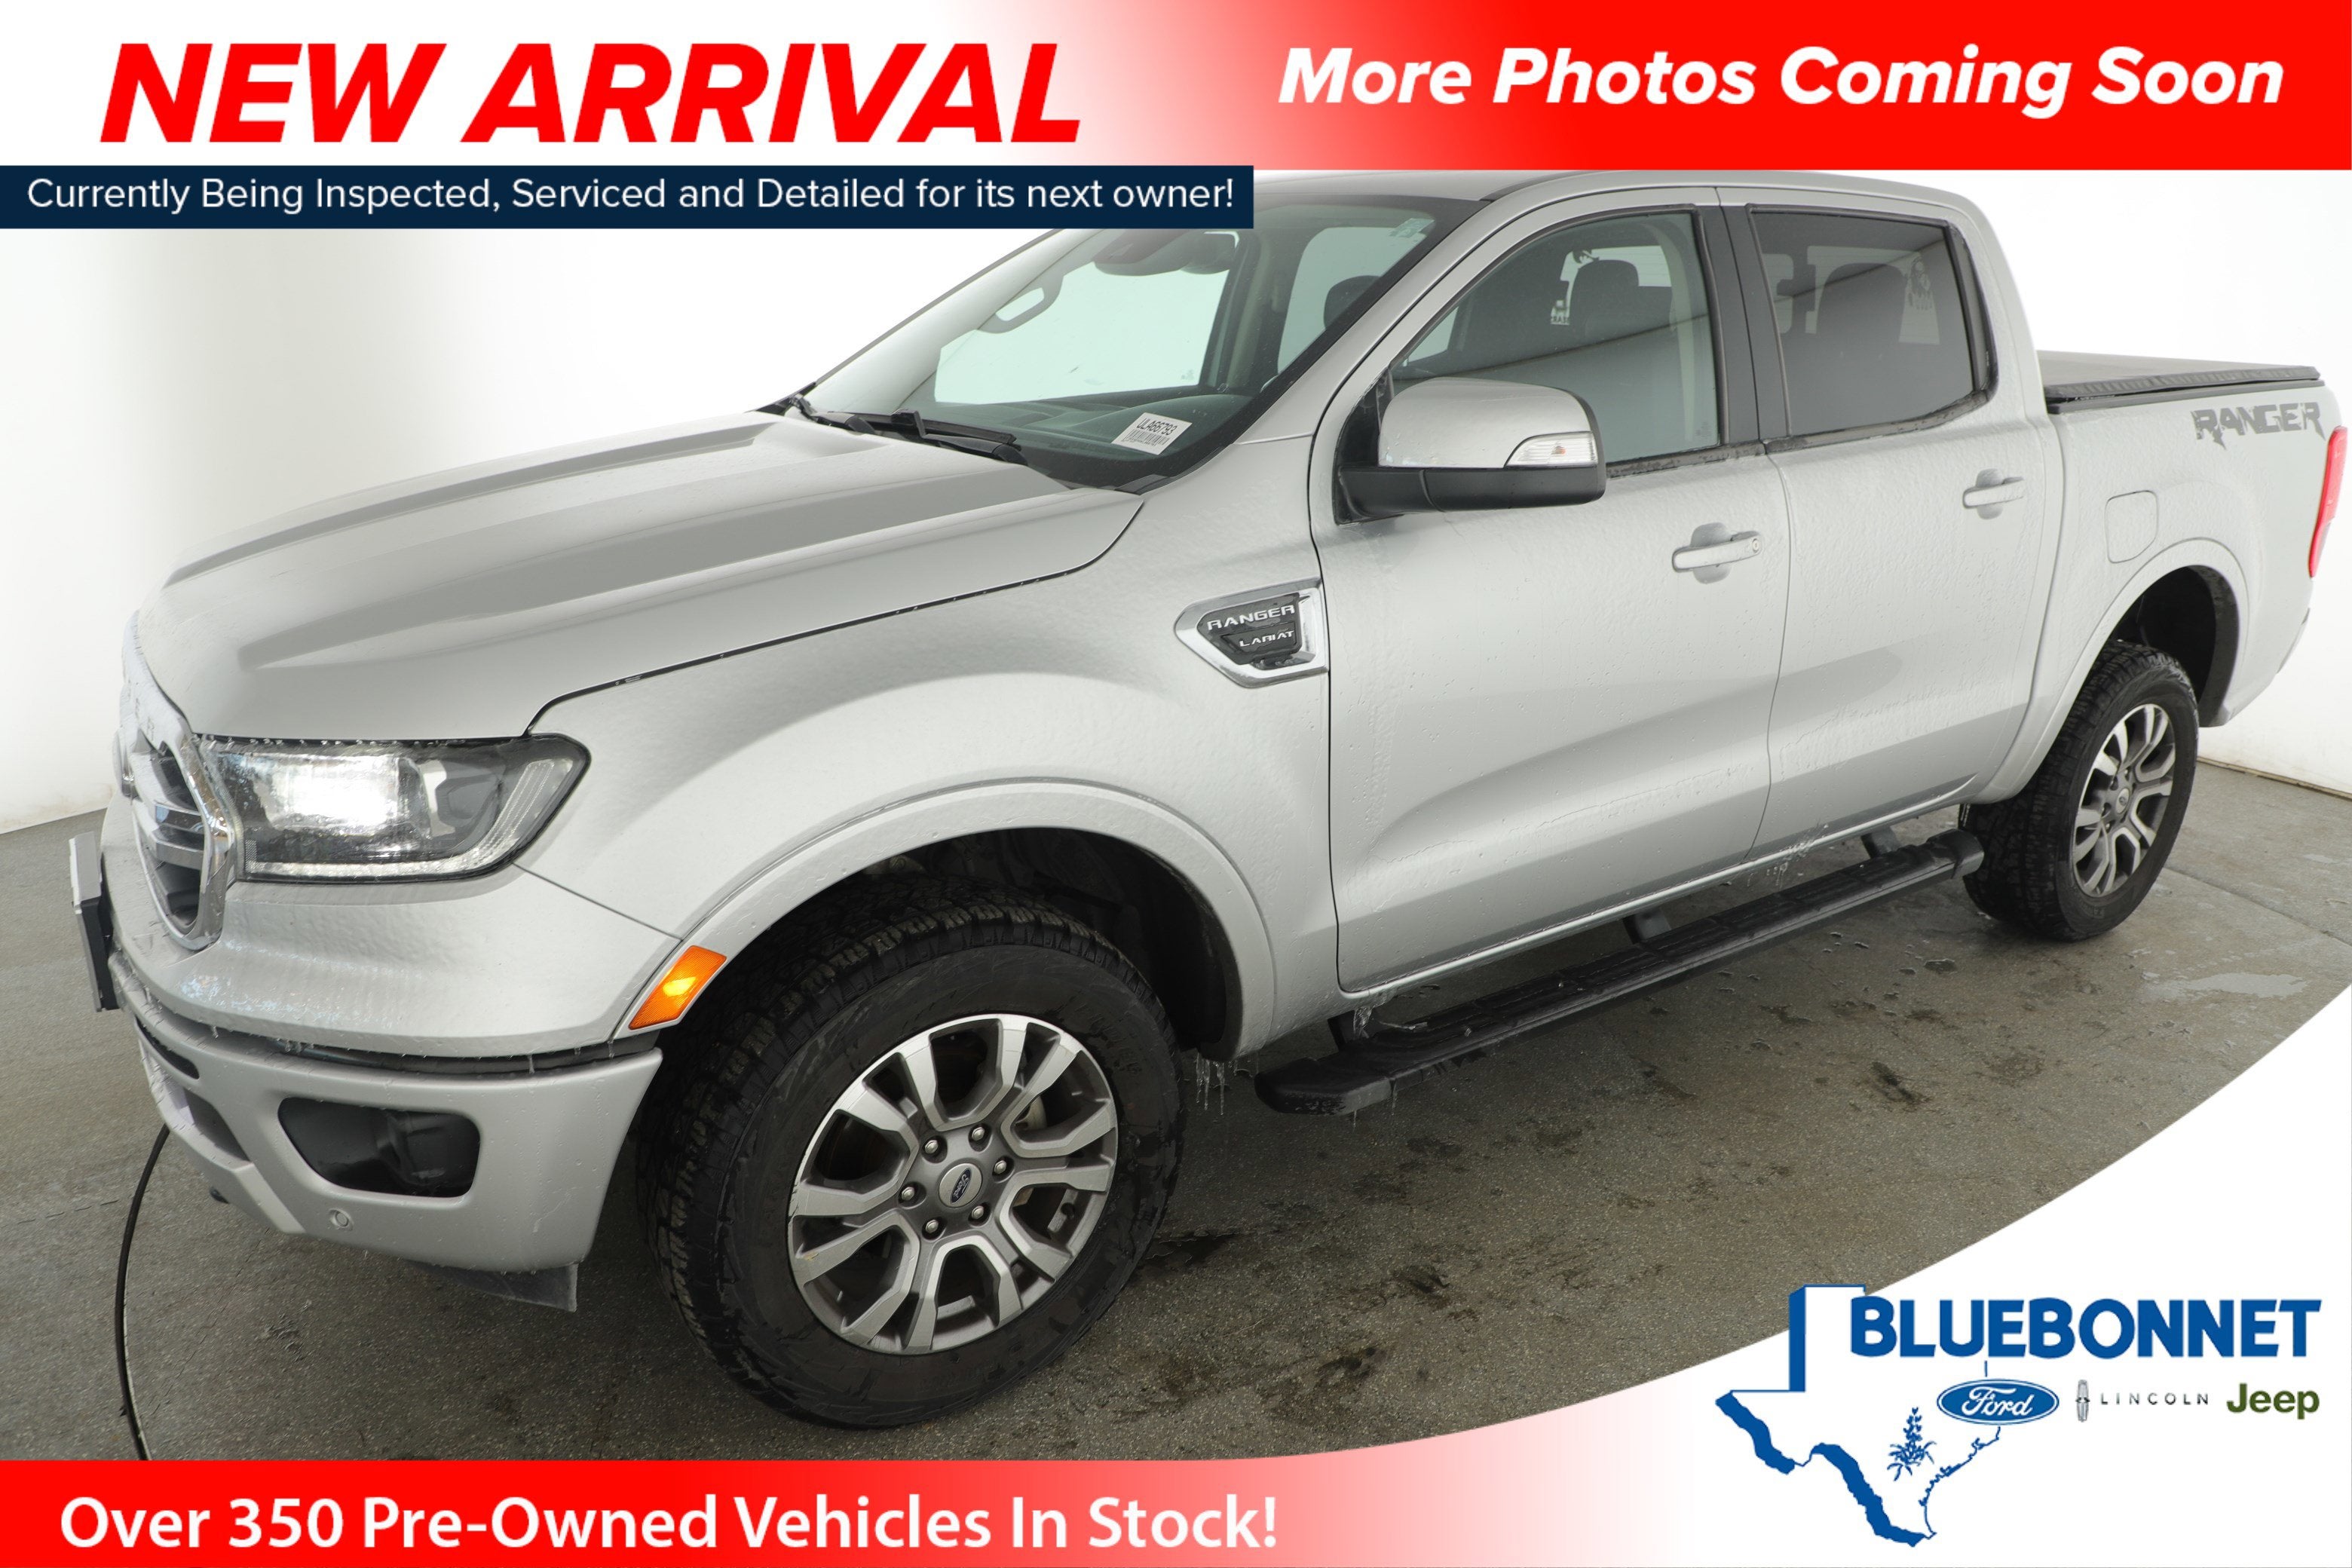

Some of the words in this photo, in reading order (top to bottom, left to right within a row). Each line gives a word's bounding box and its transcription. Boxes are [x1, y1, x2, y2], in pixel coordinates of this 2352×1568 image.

[1137, 417, 1178, 436] ULA66793
[2191, 402, 2326, 450] RANGER
[1207, 604, 1295, 631] RANGER
[1239, 629, 1295, 648] LARIAT
